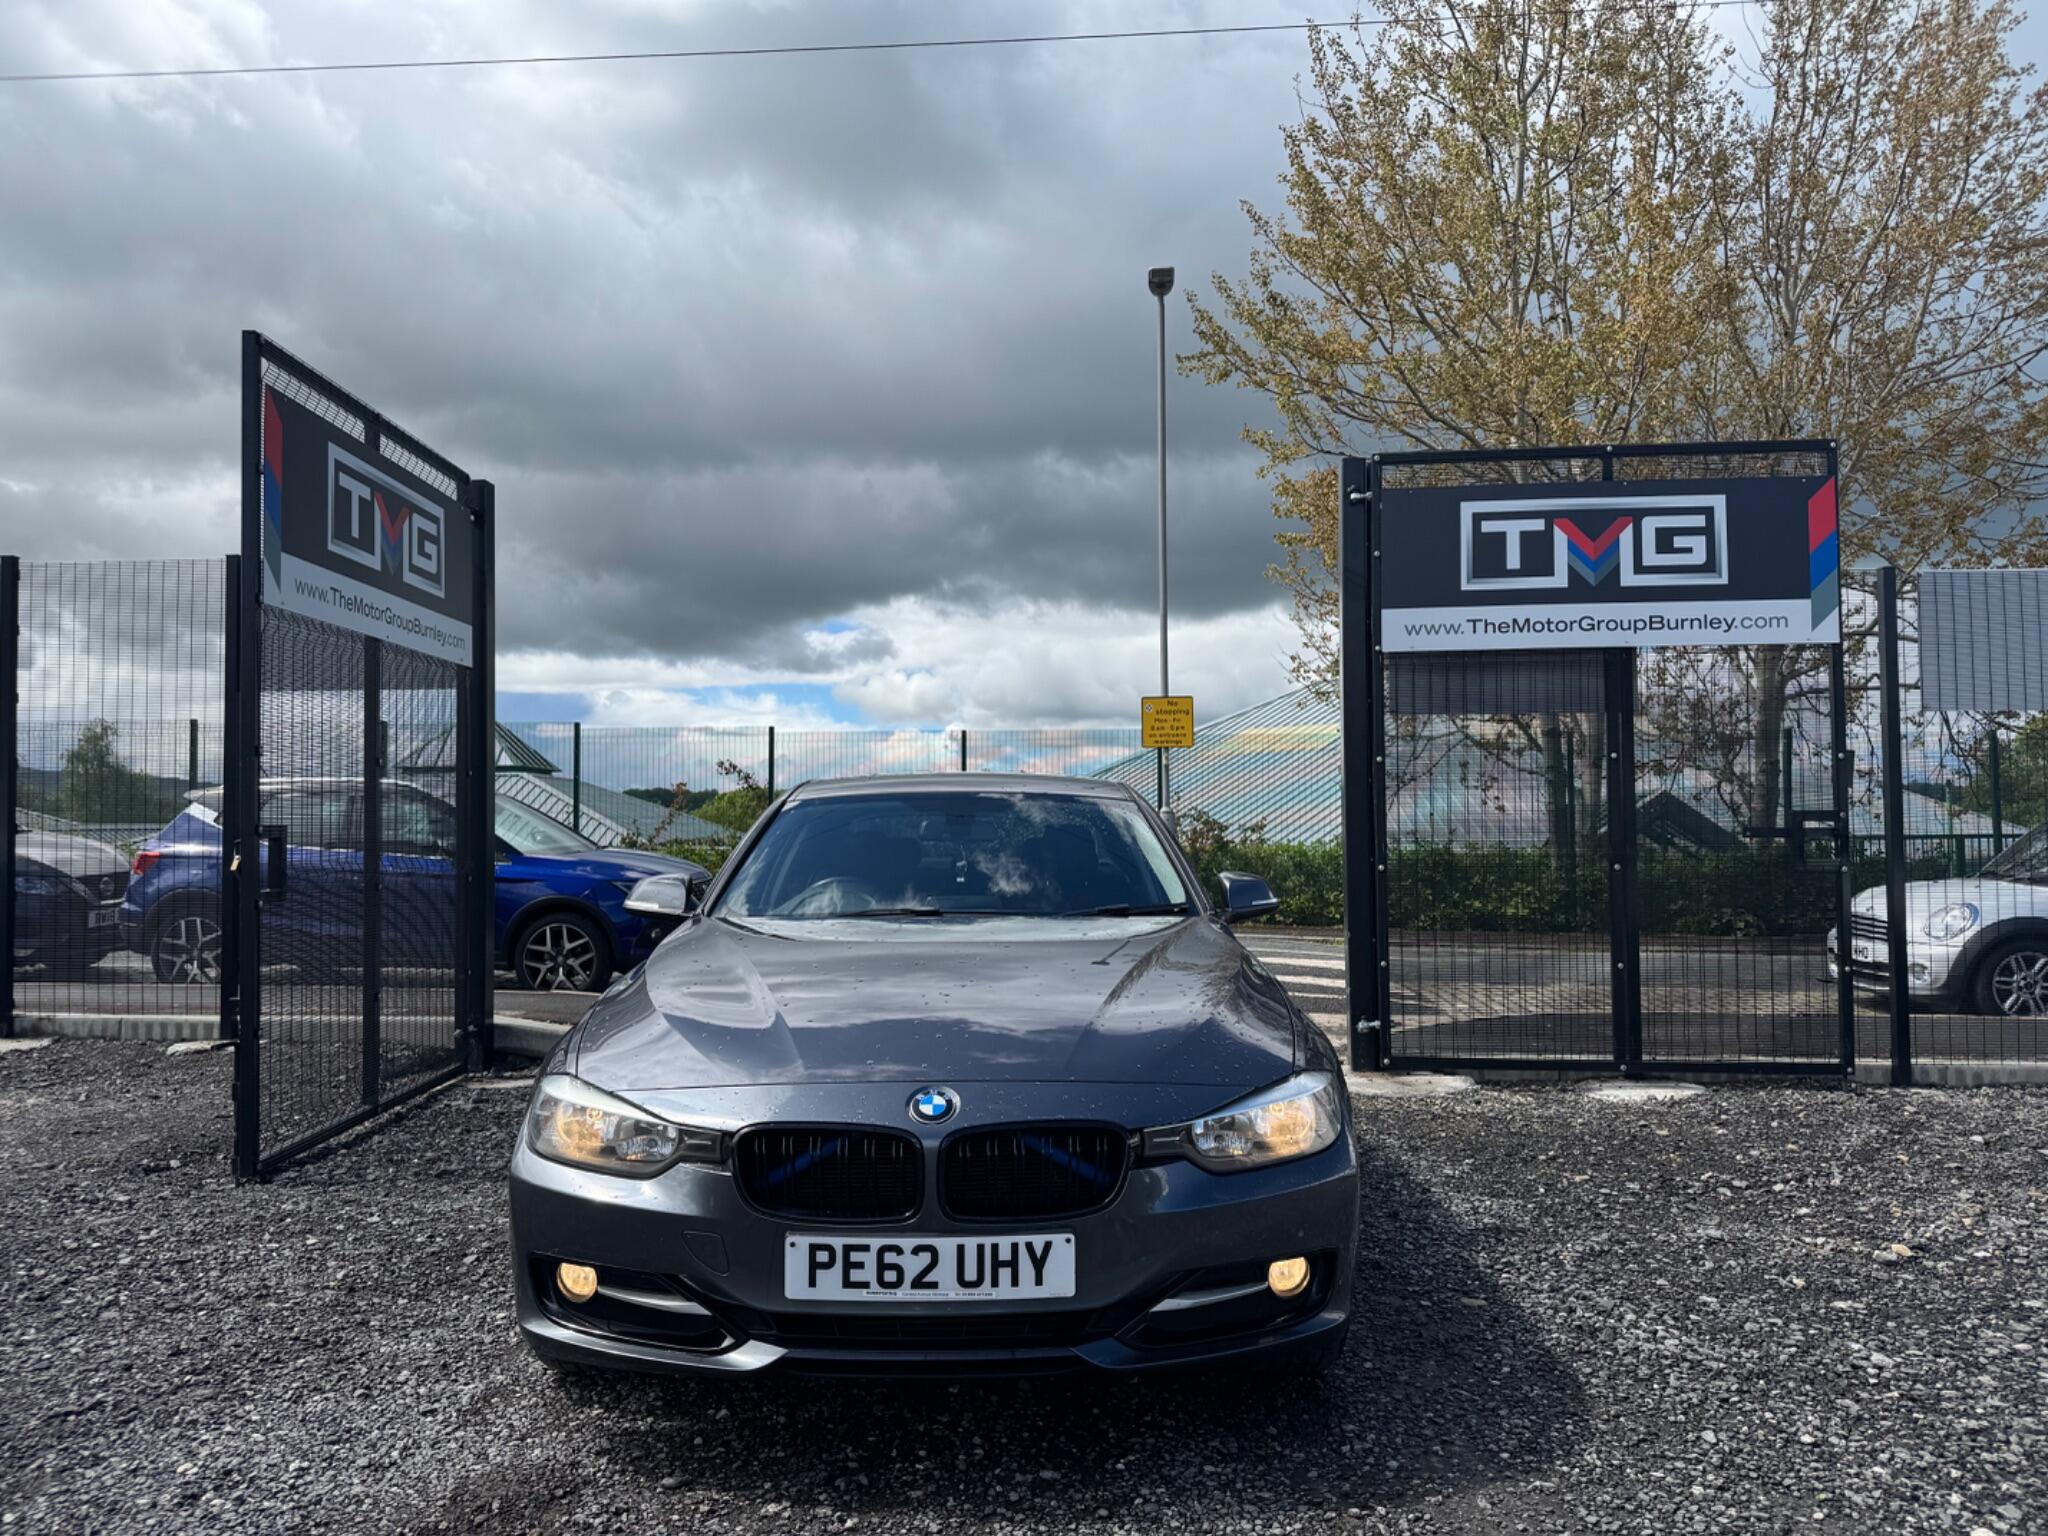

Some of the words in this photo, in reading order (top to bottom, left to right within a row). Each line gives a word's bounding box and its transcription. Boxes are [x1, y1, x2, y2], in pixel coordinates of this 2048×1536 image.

[338, 471, 438, 576] TMG
[1481, 515, 1707, 587] TMG
[294, 578, 466, 649] www.TheMotorGroupBurnley.com
[1404, 613, 1789, 636] www.TheMotorGroupBurnley.com
[808, 1243, 939, 1289] PE62
[956, 1241, 1053, 1288] UHY
